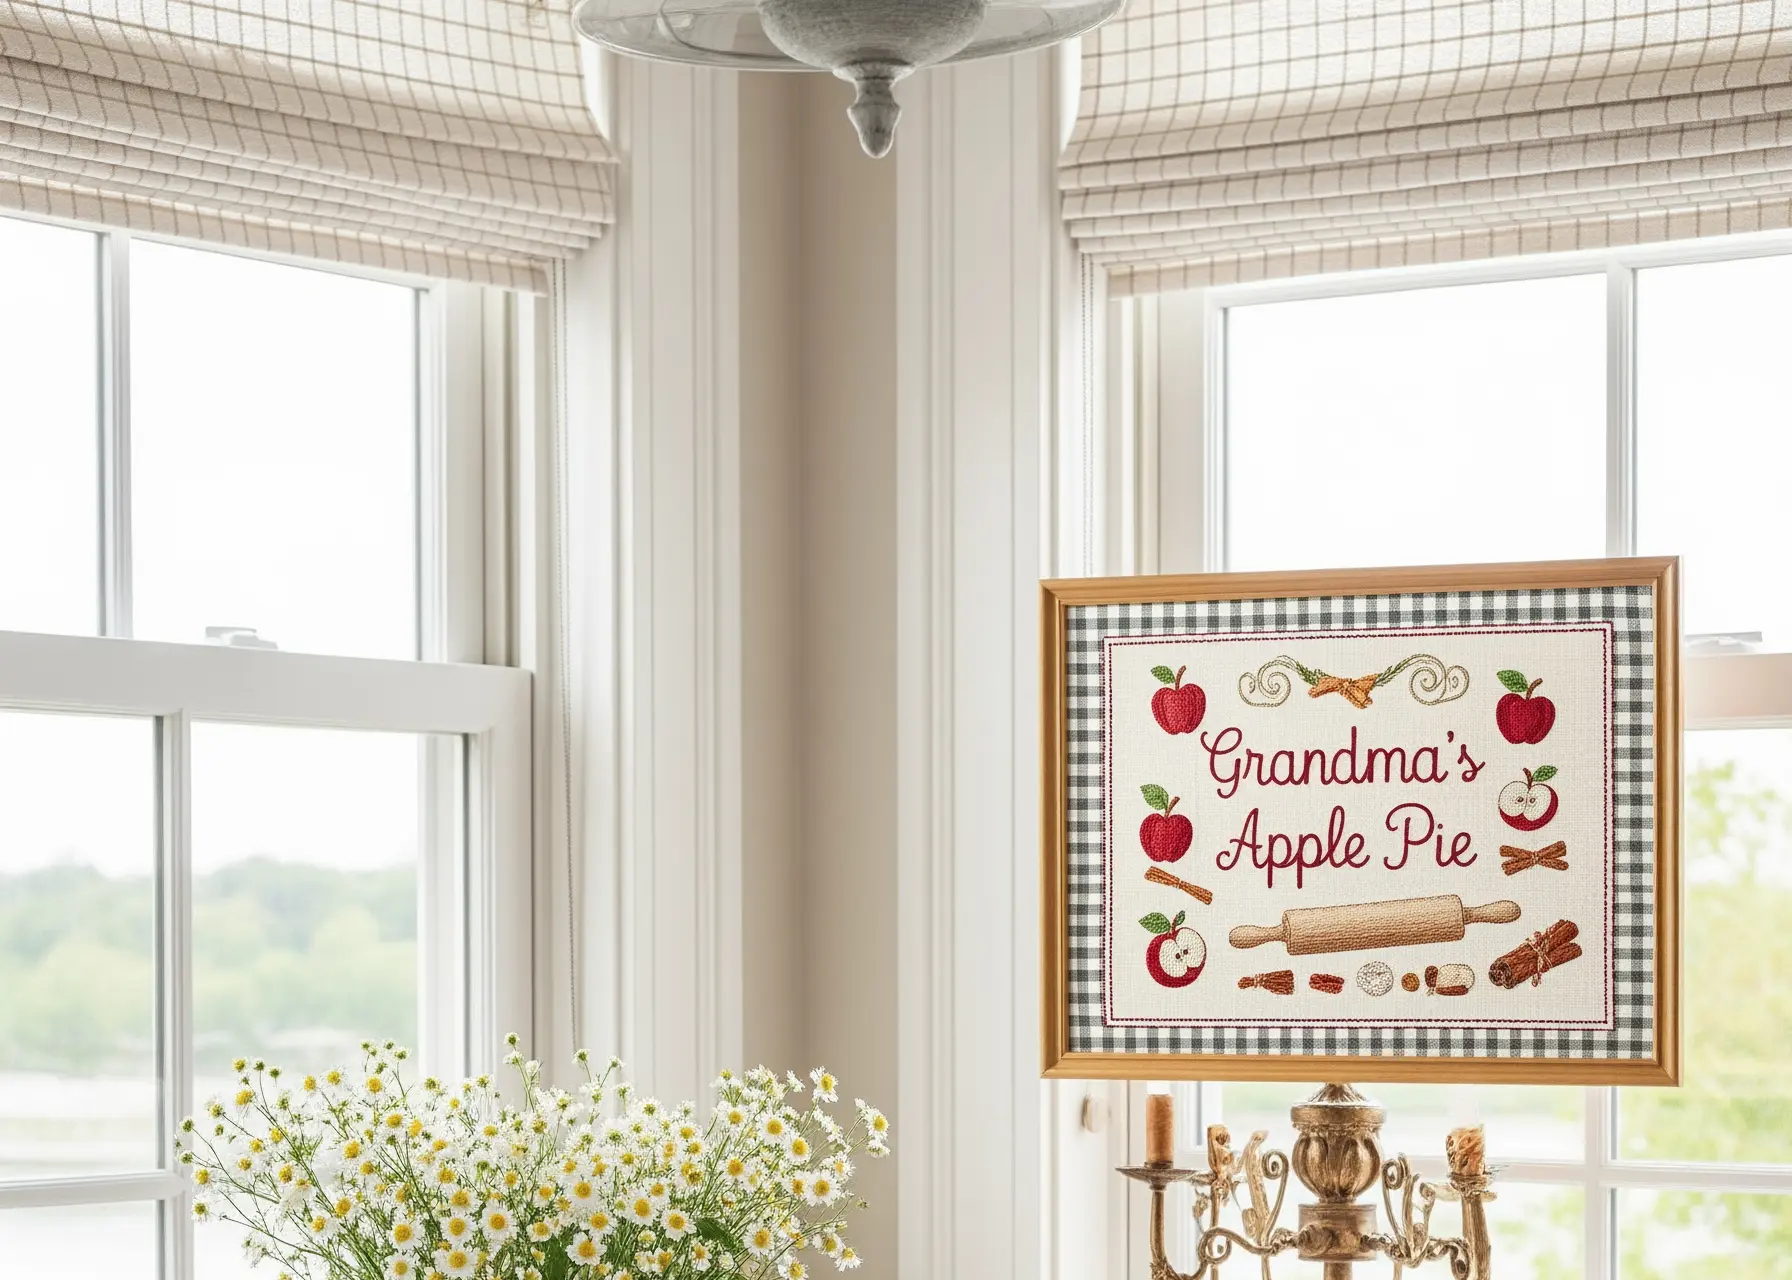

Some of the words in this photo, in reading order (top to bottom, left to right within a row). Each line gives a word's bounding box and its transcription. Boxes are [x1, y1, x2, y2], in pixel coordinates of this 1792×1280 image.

[1200, 726, 1486, 799] Grandma's
[1215, 805, 1370, 889] Apple
[1383, 802, 1477, 870] Pie
